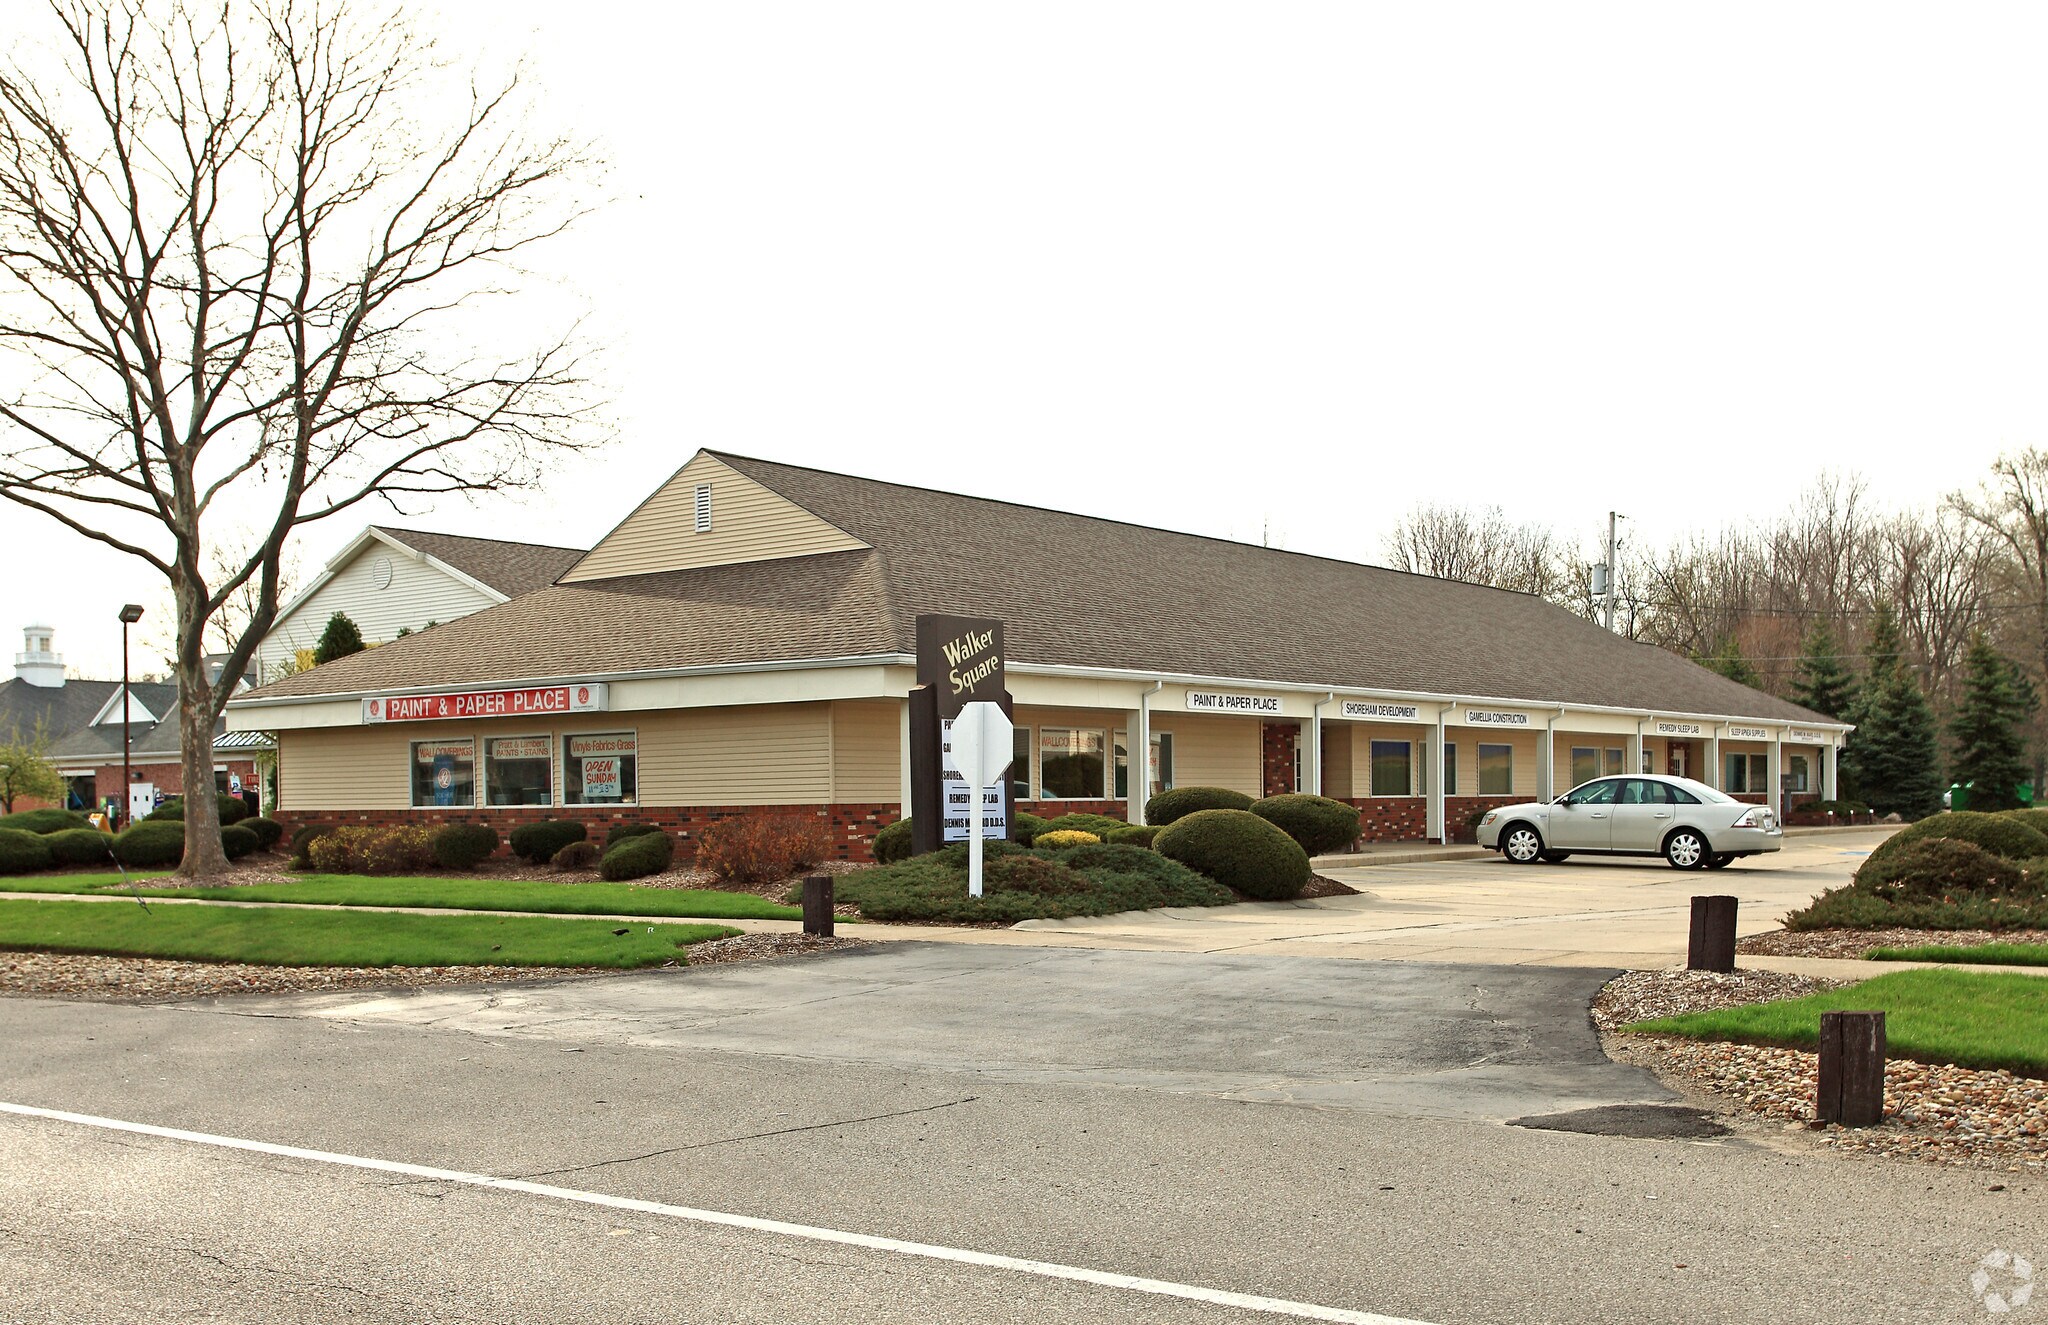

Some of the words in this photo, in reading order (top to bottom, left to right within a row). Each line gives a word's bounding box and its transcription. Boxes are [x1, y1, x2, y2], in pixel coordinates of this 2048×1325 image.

[942, 629, 993, 668] Walker
[949, 655, 999, 695] Square
[391, 698, 432, 717] PAINT
[438, 698, 448, 715] &
[456, 694, 505, 714] PAPER
[514, 690, 565, 711] PLACE
[1193, 694, 1217, 707] PAINT
[1218, 695, 1224, 708] &
[1226, 696, 1251, 709] PAPER
[1253, 698, 1278, 710] PLACE
[1346, 702, 1377, 715] SHOREHAM
[1378, 705, 1416, 718] DEVELOPMENT
[1492, 713, 1527, 724] CONSTRUCTION
[1659, 723, 1677, 732] REMEDY
[1677, 724, 1690, 733] SLEEP
[1691, 725, 1700, 734] LAB
[1731, 728, 1740, 736] SLEEP
[520, 740, 545, 748] Lambert
[1042, 736, 1096, 748] WALLCOVEGS
[496, 749, 519, 757] PAINTS
[524, 748, 549, 756] STAINS
[585, 760, 613, 772] OPEN
[586, 773, 616, 784] SUNDAY
[988, 793, 999, 803] LAB
[944, 818, 965, 828] DENNIS
